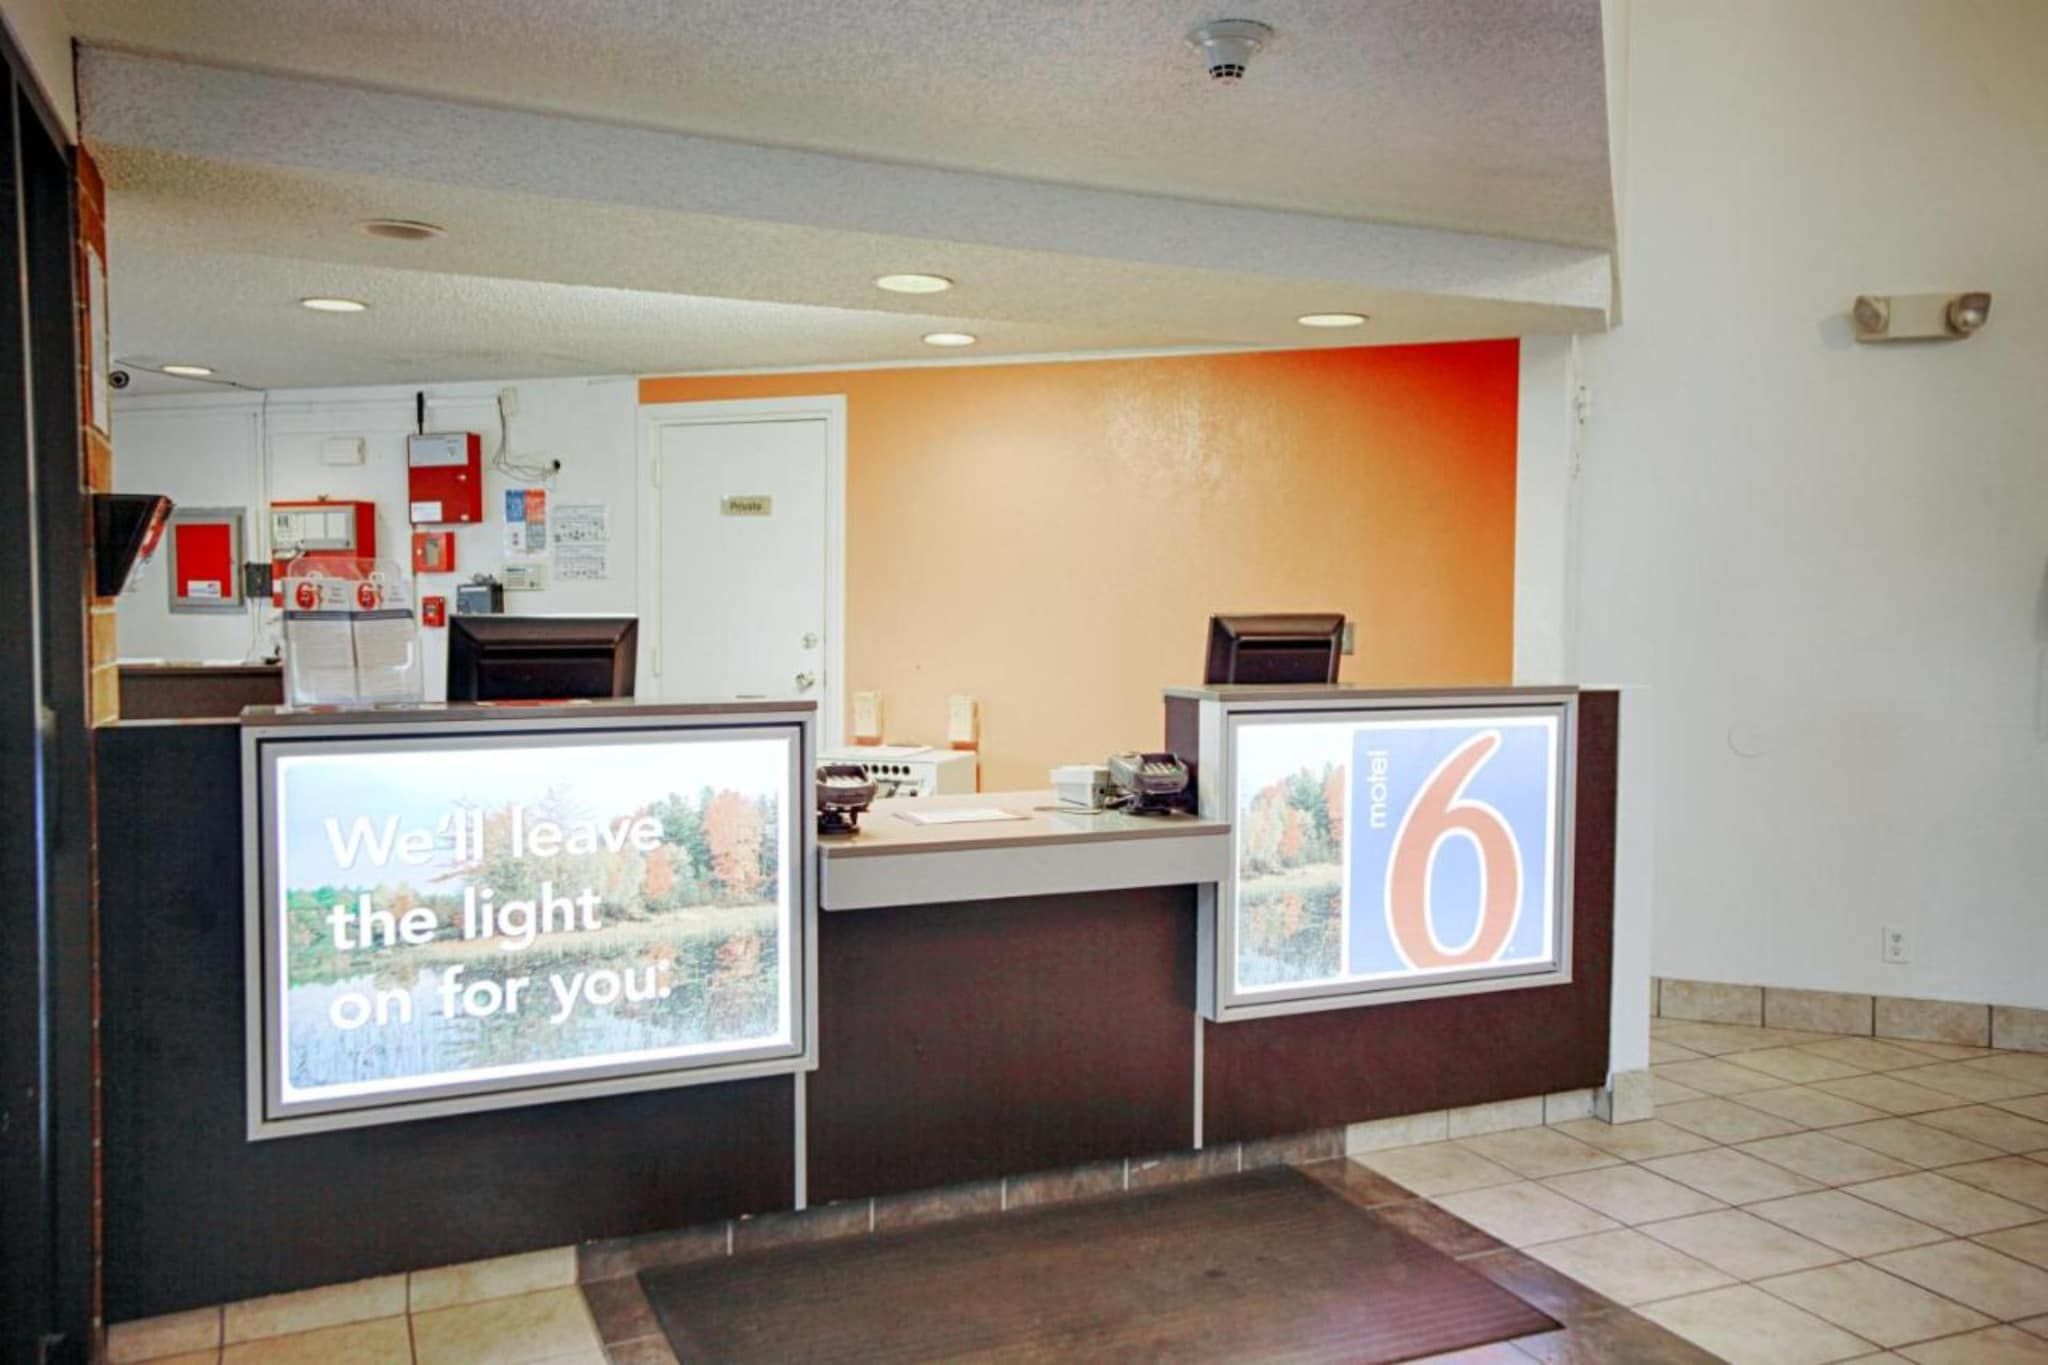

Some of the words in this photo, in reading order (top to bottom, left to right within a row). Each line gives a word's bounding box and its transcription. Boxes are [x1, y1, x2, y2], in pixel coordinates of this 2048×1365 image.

[729, 500, 762, 511] Private
[1367, 750, 1388, 828] motel
[325, 808, 484, 869] We'll
[512, 807, 662, 858] leave
[1385, 730, 1523, 969] 6
[326, 894, 438, 950] the
[464, 882, 602, 950] light
[330, 989, 411, 1030] on
[441, 966, 530, 1018] for
[550, 964, 671, 1024] you.
